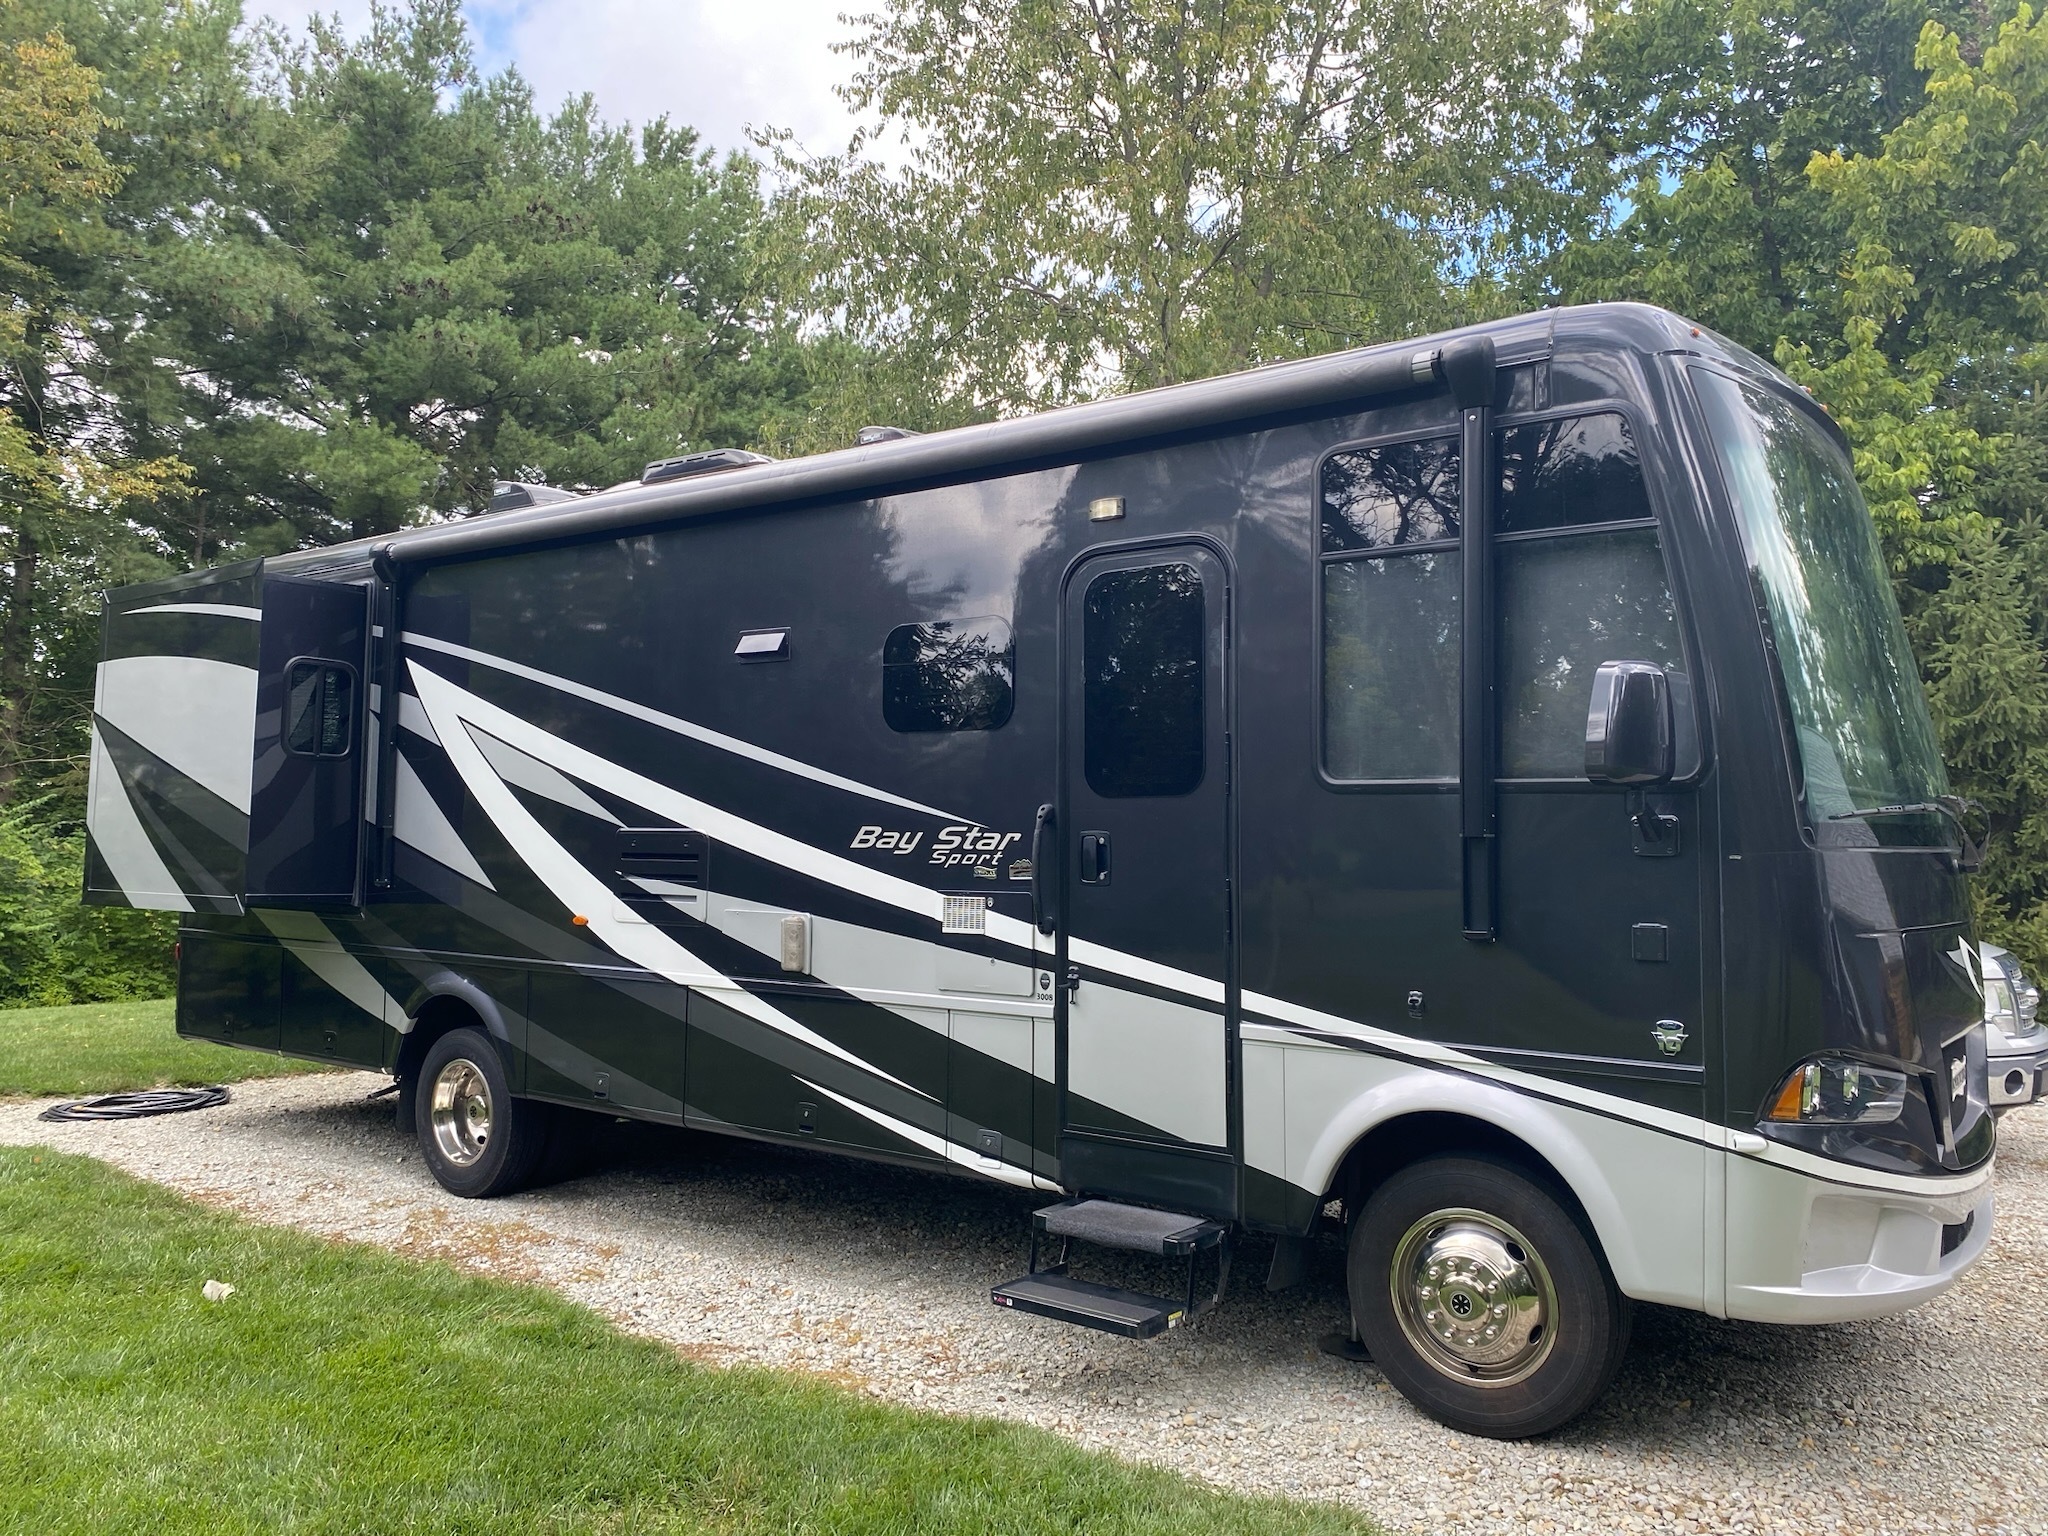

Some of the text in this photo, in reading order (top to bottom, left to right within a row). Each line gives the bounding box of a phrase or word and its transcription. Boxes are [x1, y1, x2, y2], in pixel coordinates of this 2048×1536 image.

[849, 825, 1022, 855] Bay Star
[928, 850, 1004, 869] Sport
